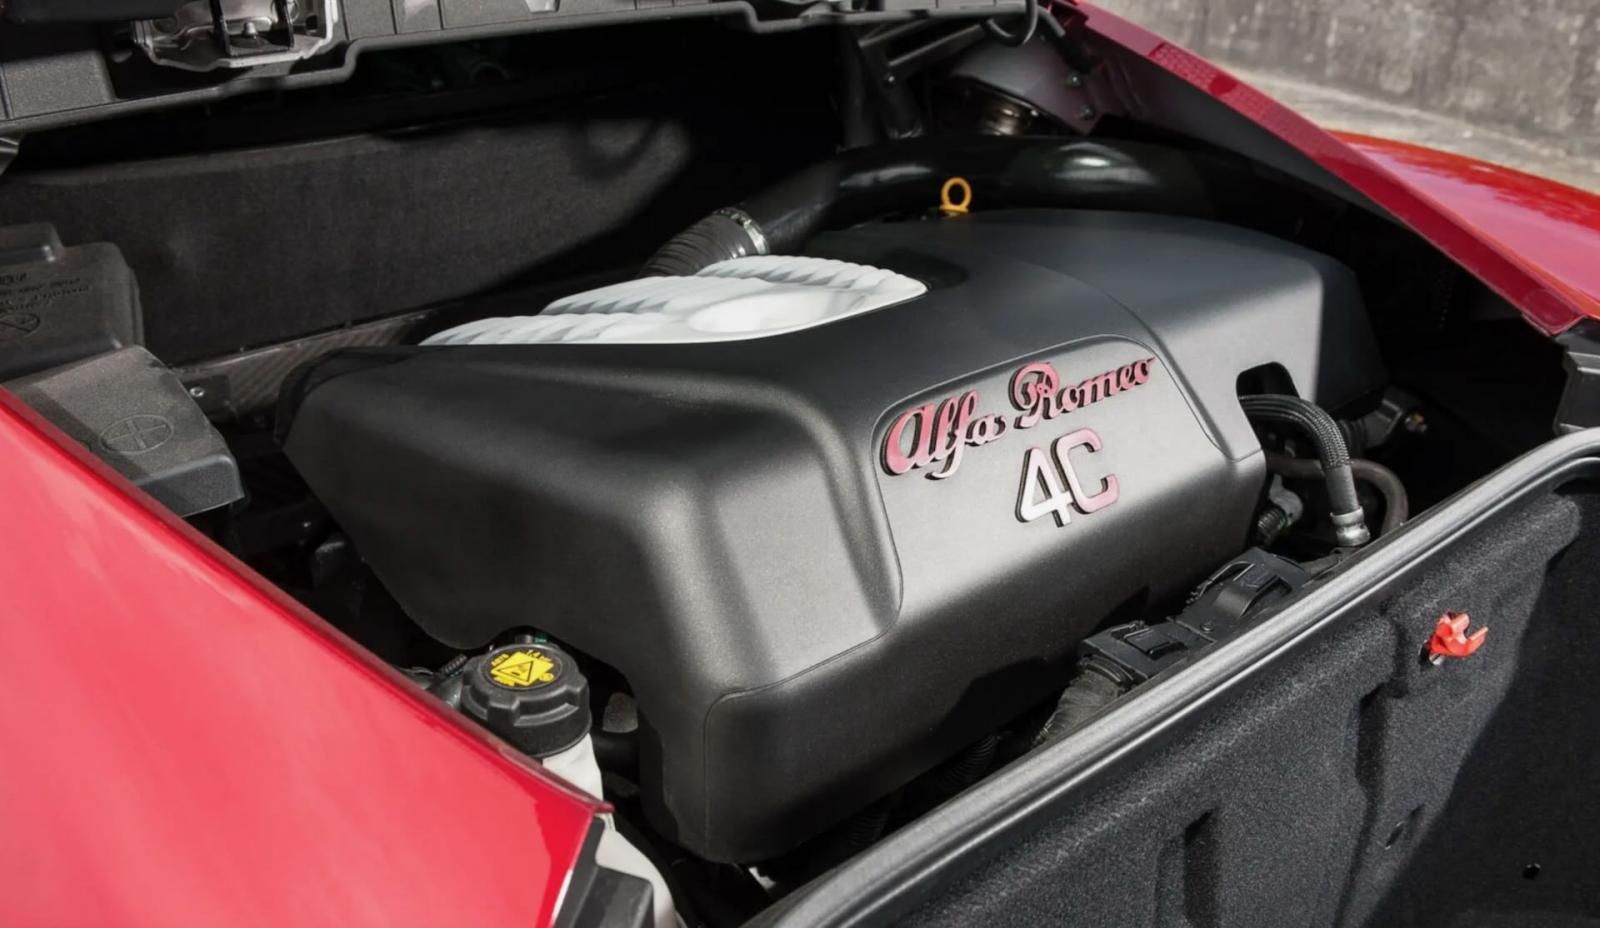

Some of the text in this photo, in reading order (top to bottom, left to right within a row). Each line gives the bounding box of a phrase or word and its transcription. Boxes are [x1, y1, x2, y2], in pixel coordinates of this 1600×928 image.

[880, 357, 1155, 479] Alfa Romeo
[1014, 427, 1120, 528] 4C
